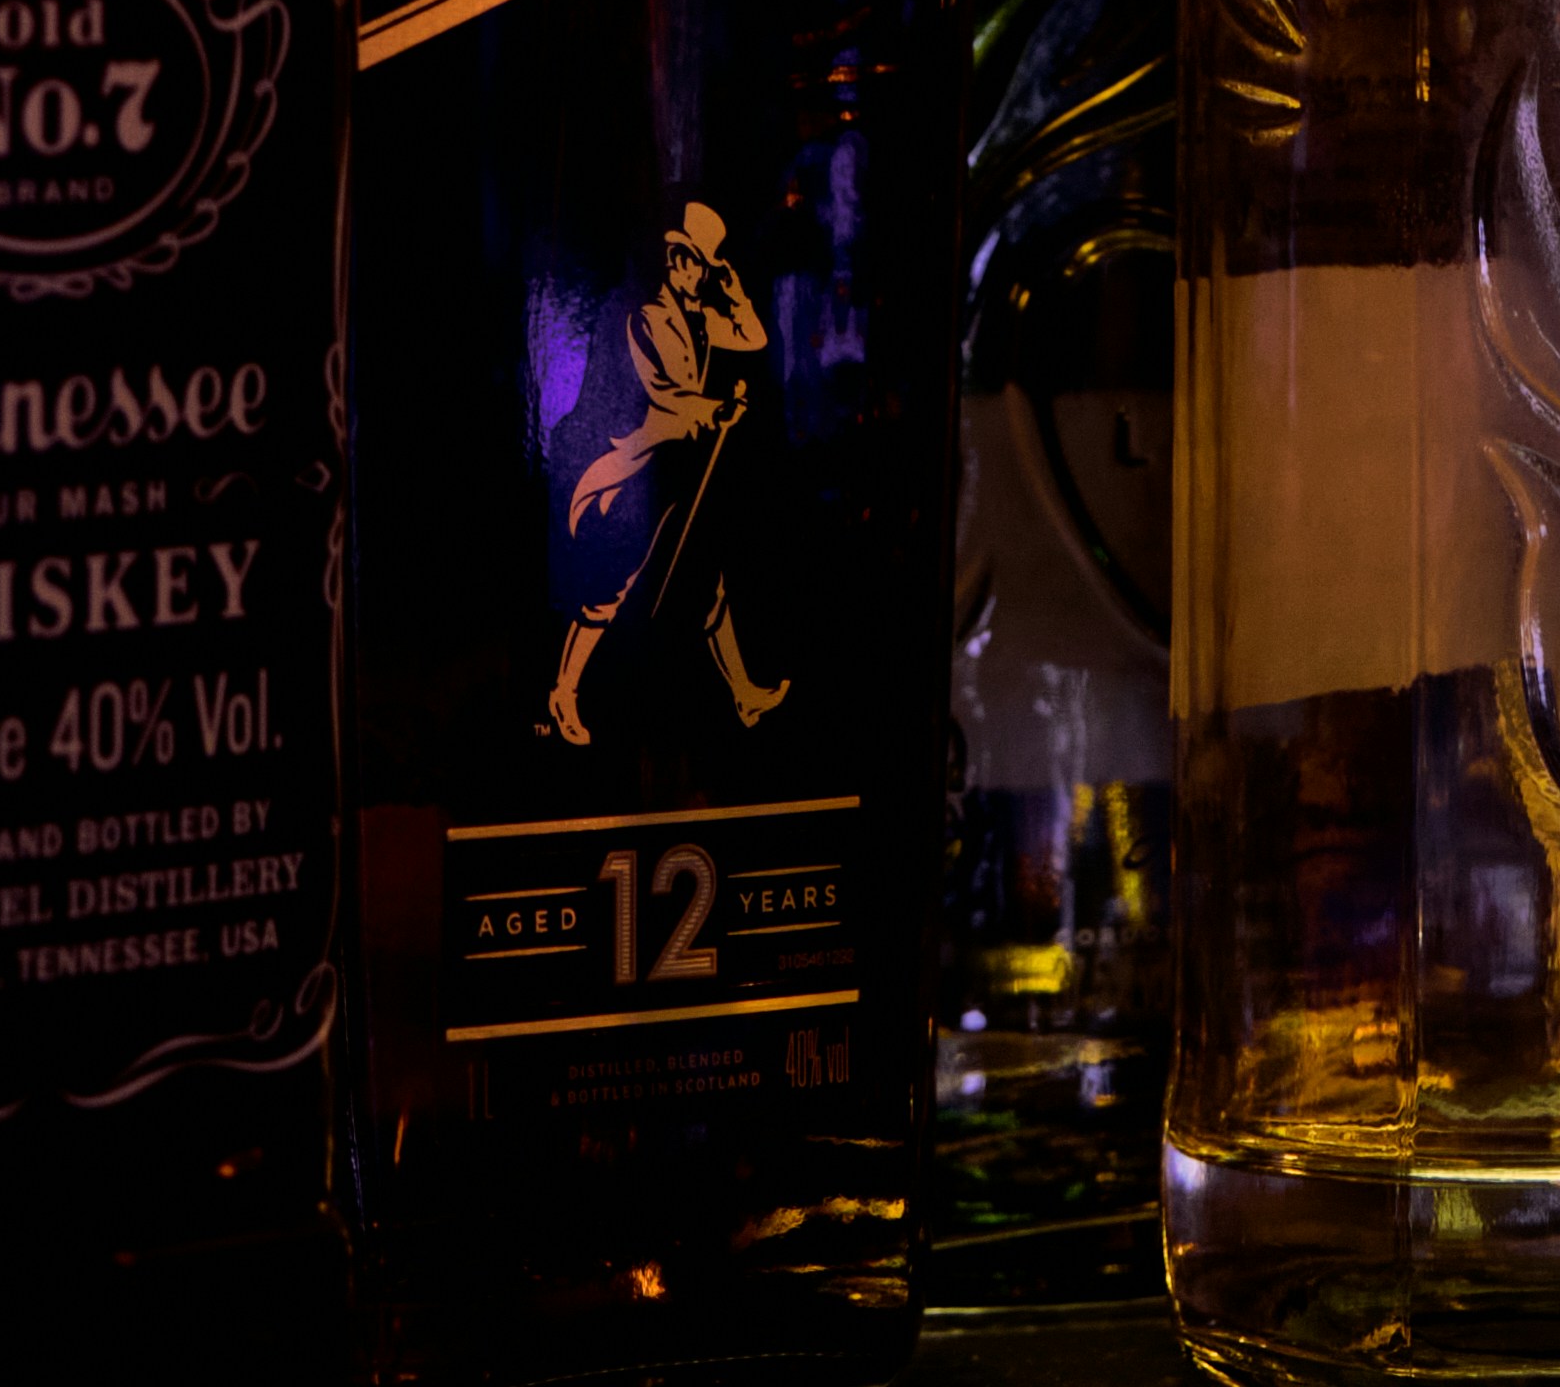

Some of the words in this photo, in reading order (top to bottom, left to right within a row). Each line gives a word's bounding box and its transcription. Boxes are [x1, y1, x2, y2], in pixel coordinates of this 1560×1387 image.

[56, 477, 171, 524] MASH
[47, 675, 178, 776] 40%
[191, 665, 286, 760] Vol.
[73, 802, 222, 857] BOTTLED
[228, 795, 274, 837] BY
[63, 849, 307, 922] DISTILLERY
[476, 906, 579, 939] AGED
[594, 841, 721, 990] 12
[737, 881, 839, 916] YEARS
[217, 916, 282, 961] USA
[566, 1083, 646, 1107] BOTTLED
[673, 1070, 763, 1097] SCOTLAND
[666, 1048, 745, 1074] BLENDED
[784, 1027, 823, 1091] 40%
